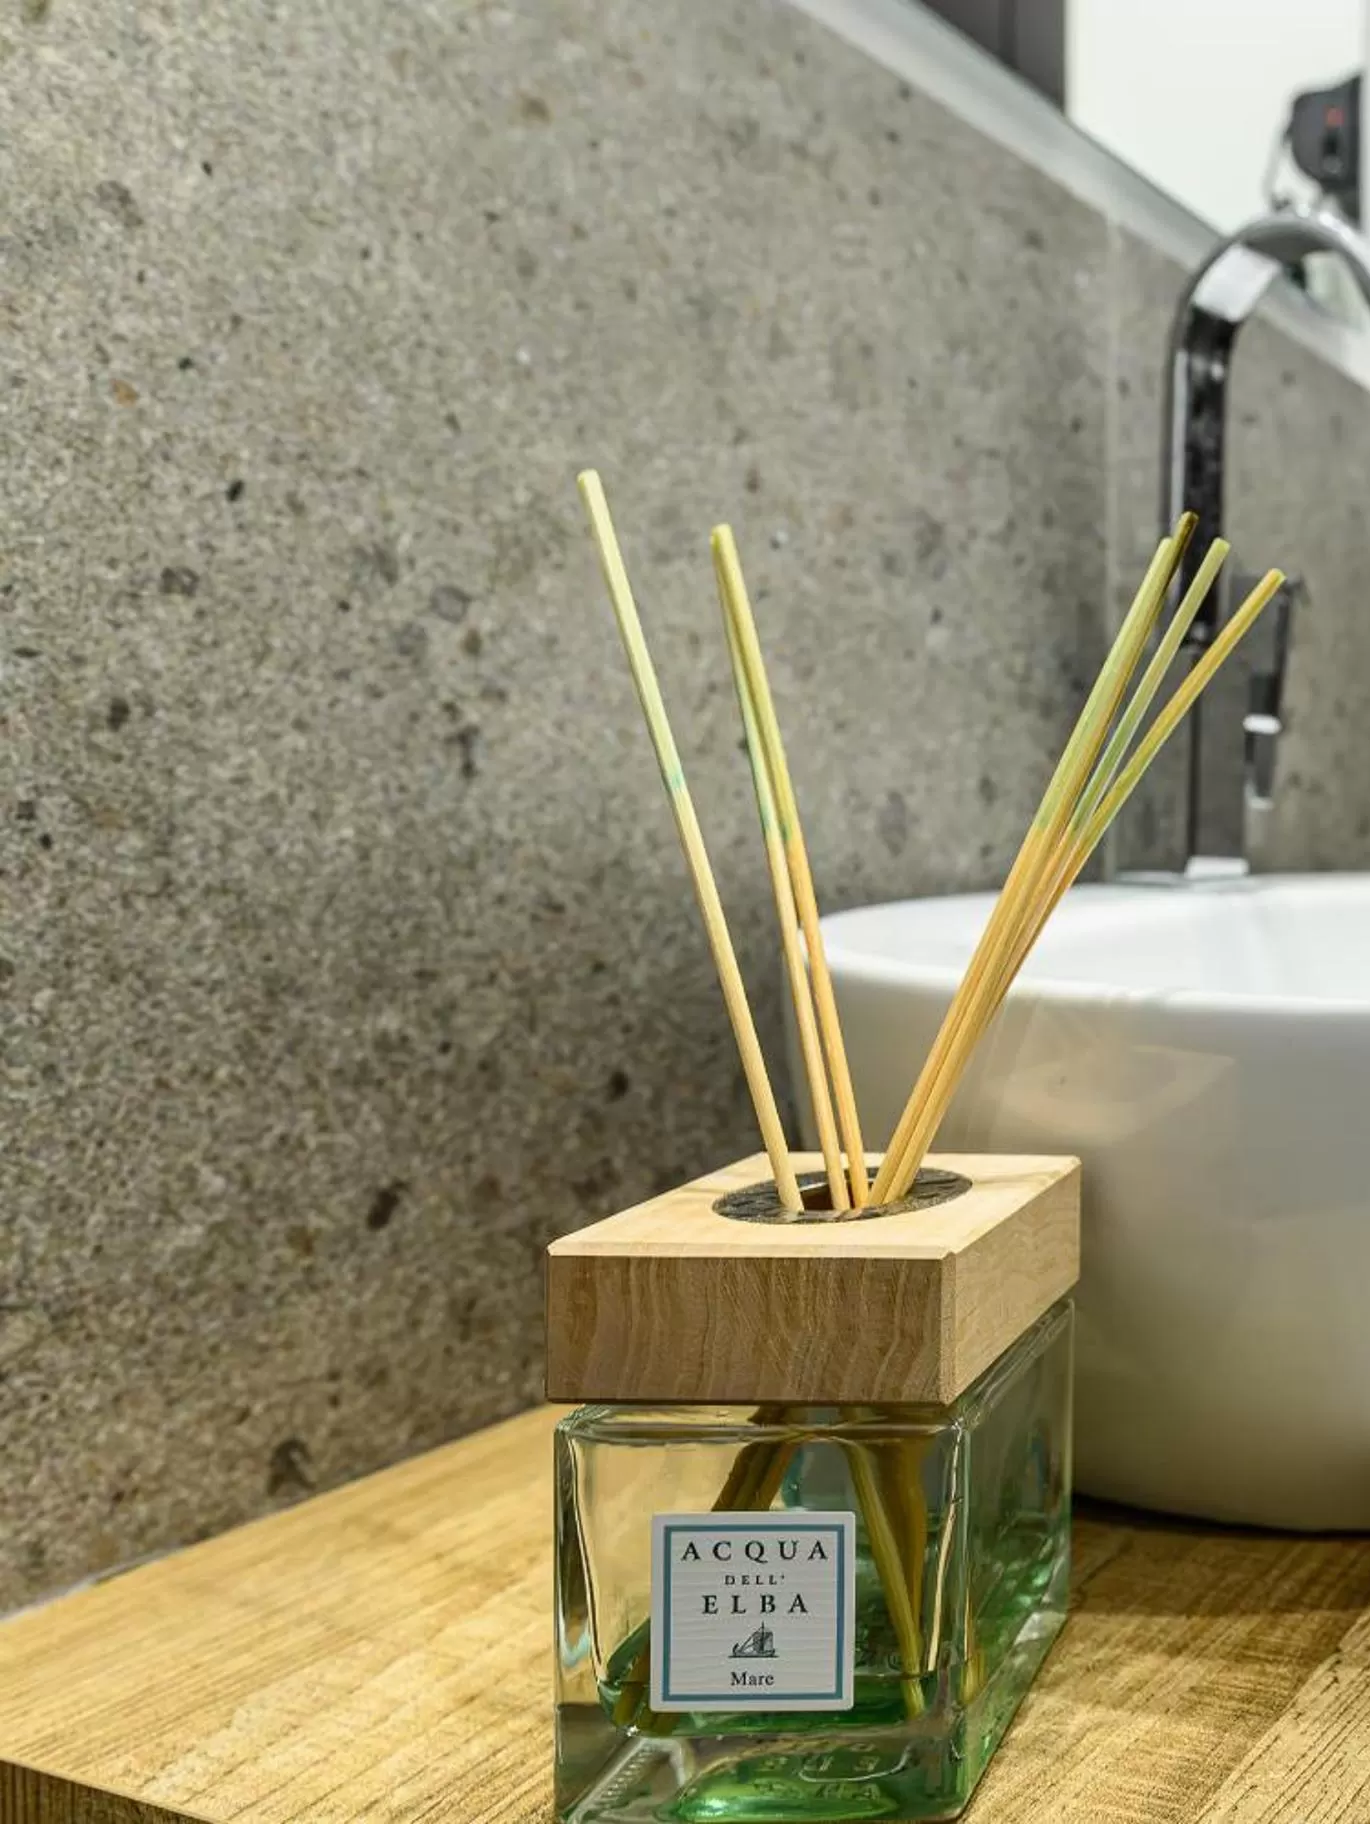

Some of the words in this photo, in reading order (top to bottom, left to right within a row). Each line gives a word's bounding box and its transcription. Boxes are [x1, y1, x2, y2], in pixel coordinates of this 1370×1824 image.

[680, 1540, 828, 1564] ACQUA
[724, 1575, 785, 1586] DELL'
[701, 1593, 809, 1615] ELBA
[730, 1671, 775, 1687] Mare
